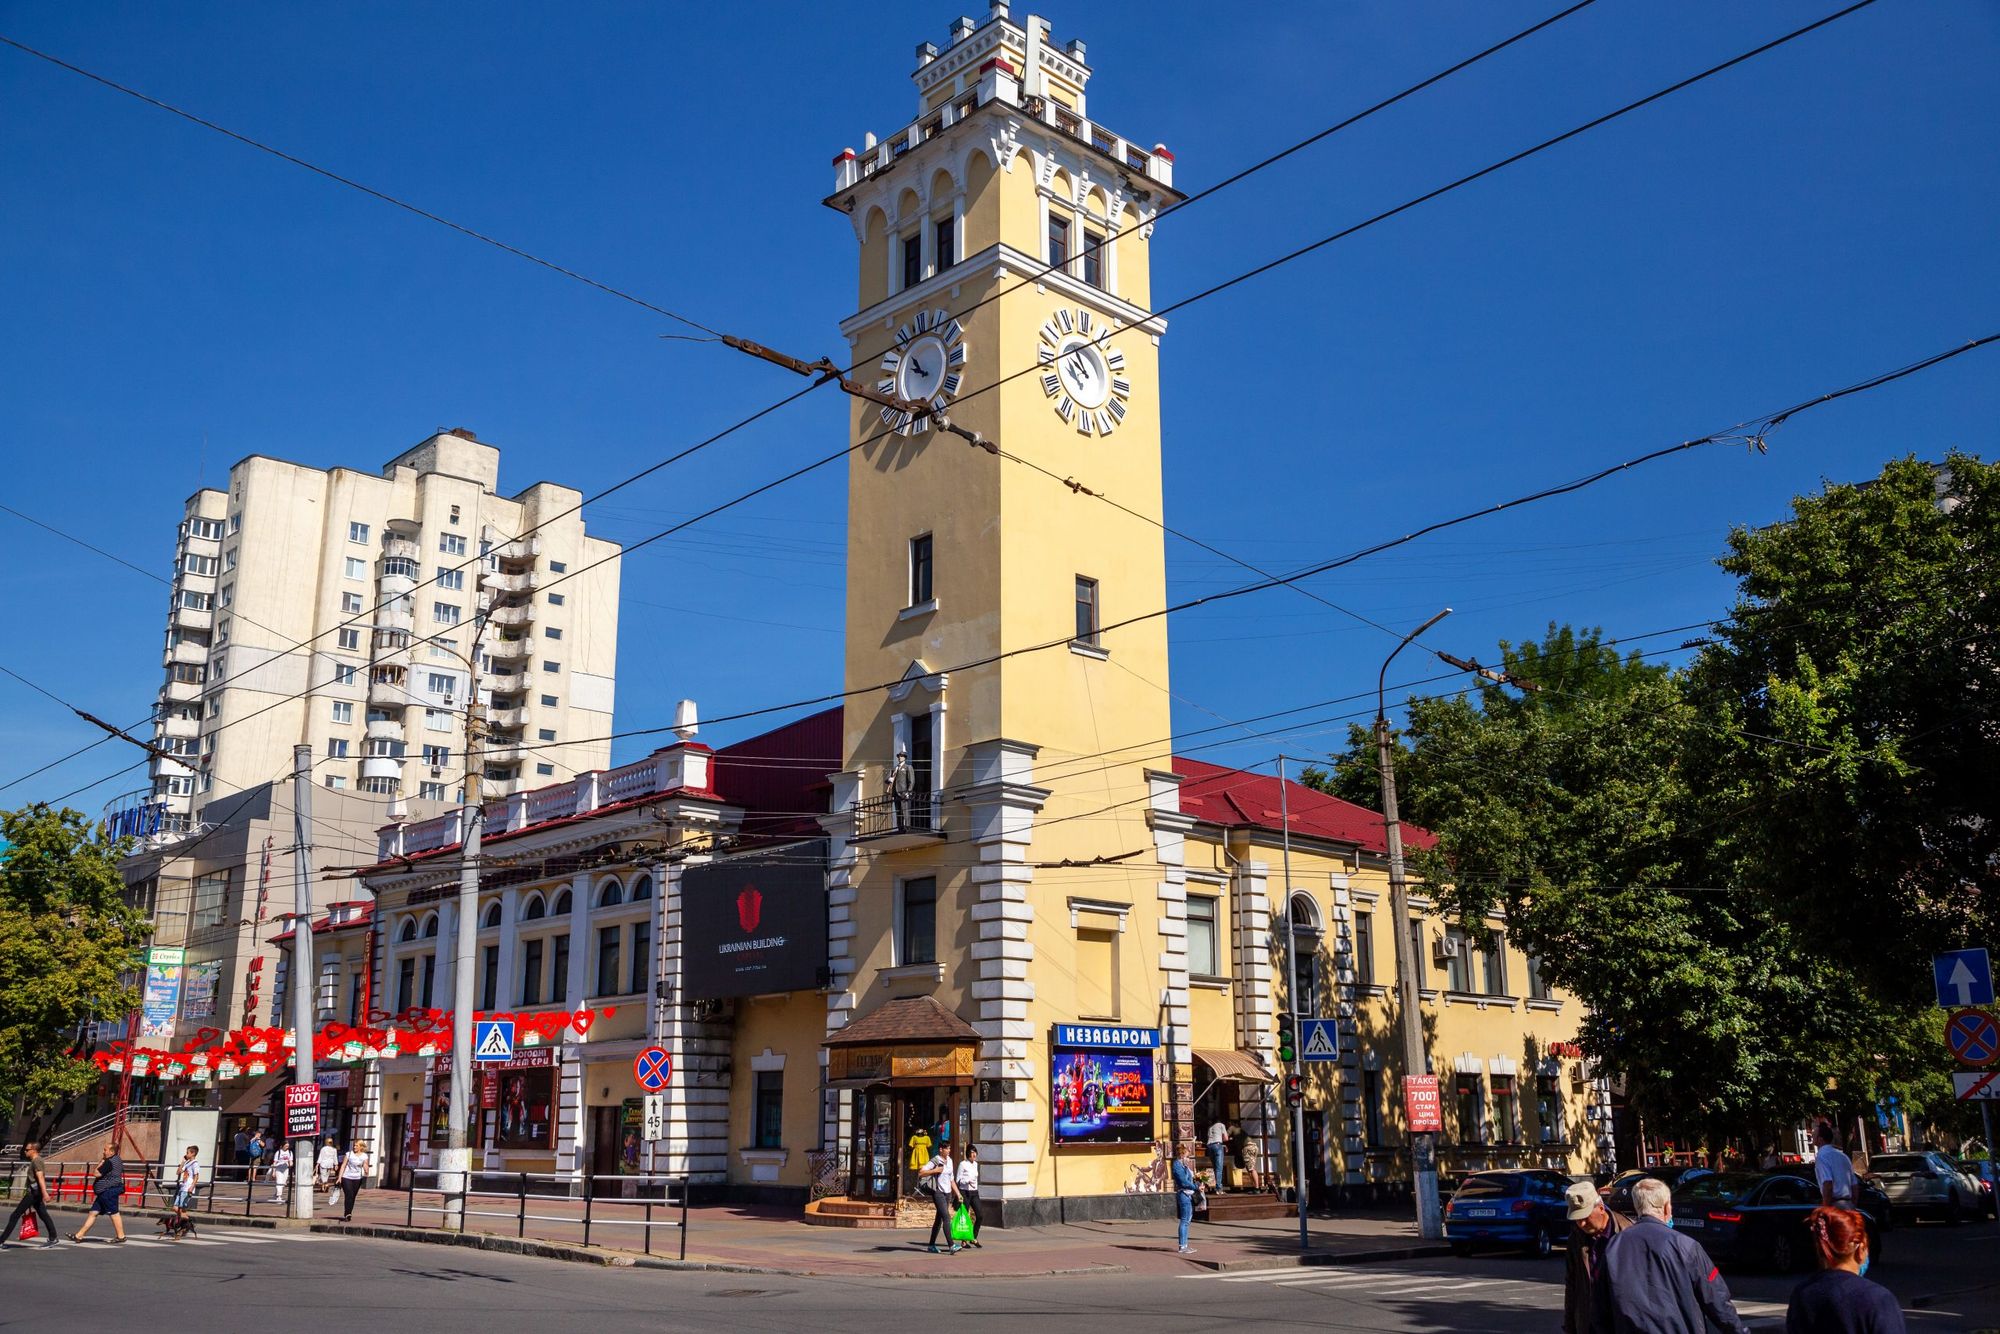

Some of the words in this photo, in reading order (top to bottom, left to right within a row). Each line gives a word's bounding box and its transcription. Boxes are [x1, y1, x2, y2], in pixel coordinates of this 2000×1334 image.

[1108, 354, 1124, 365] II
[1113, 379, 1130, 392] III
[718, 940, 752, 954] UKRAINIAN
[752, 936, 785, 950] BUILDING
[1066, 1028, 1151, 1045] НЕЗАБАРОМ
[512, 1048, 547, 1059] ЬОГОДНІ
[290, 1085, 315, 1093] ТАКСІ
[288, 1091, 319, 1104] 7007
[1411, 1091, 1437, 1102] 7007
[289, 1107, 316, 1116] ВНОЧІ
[288, 1115, 317, 1124] ОБВАЛ
[647, 1116, 661, 1128] 45
[292, 1124, 314, 1132] ЦІНИ
